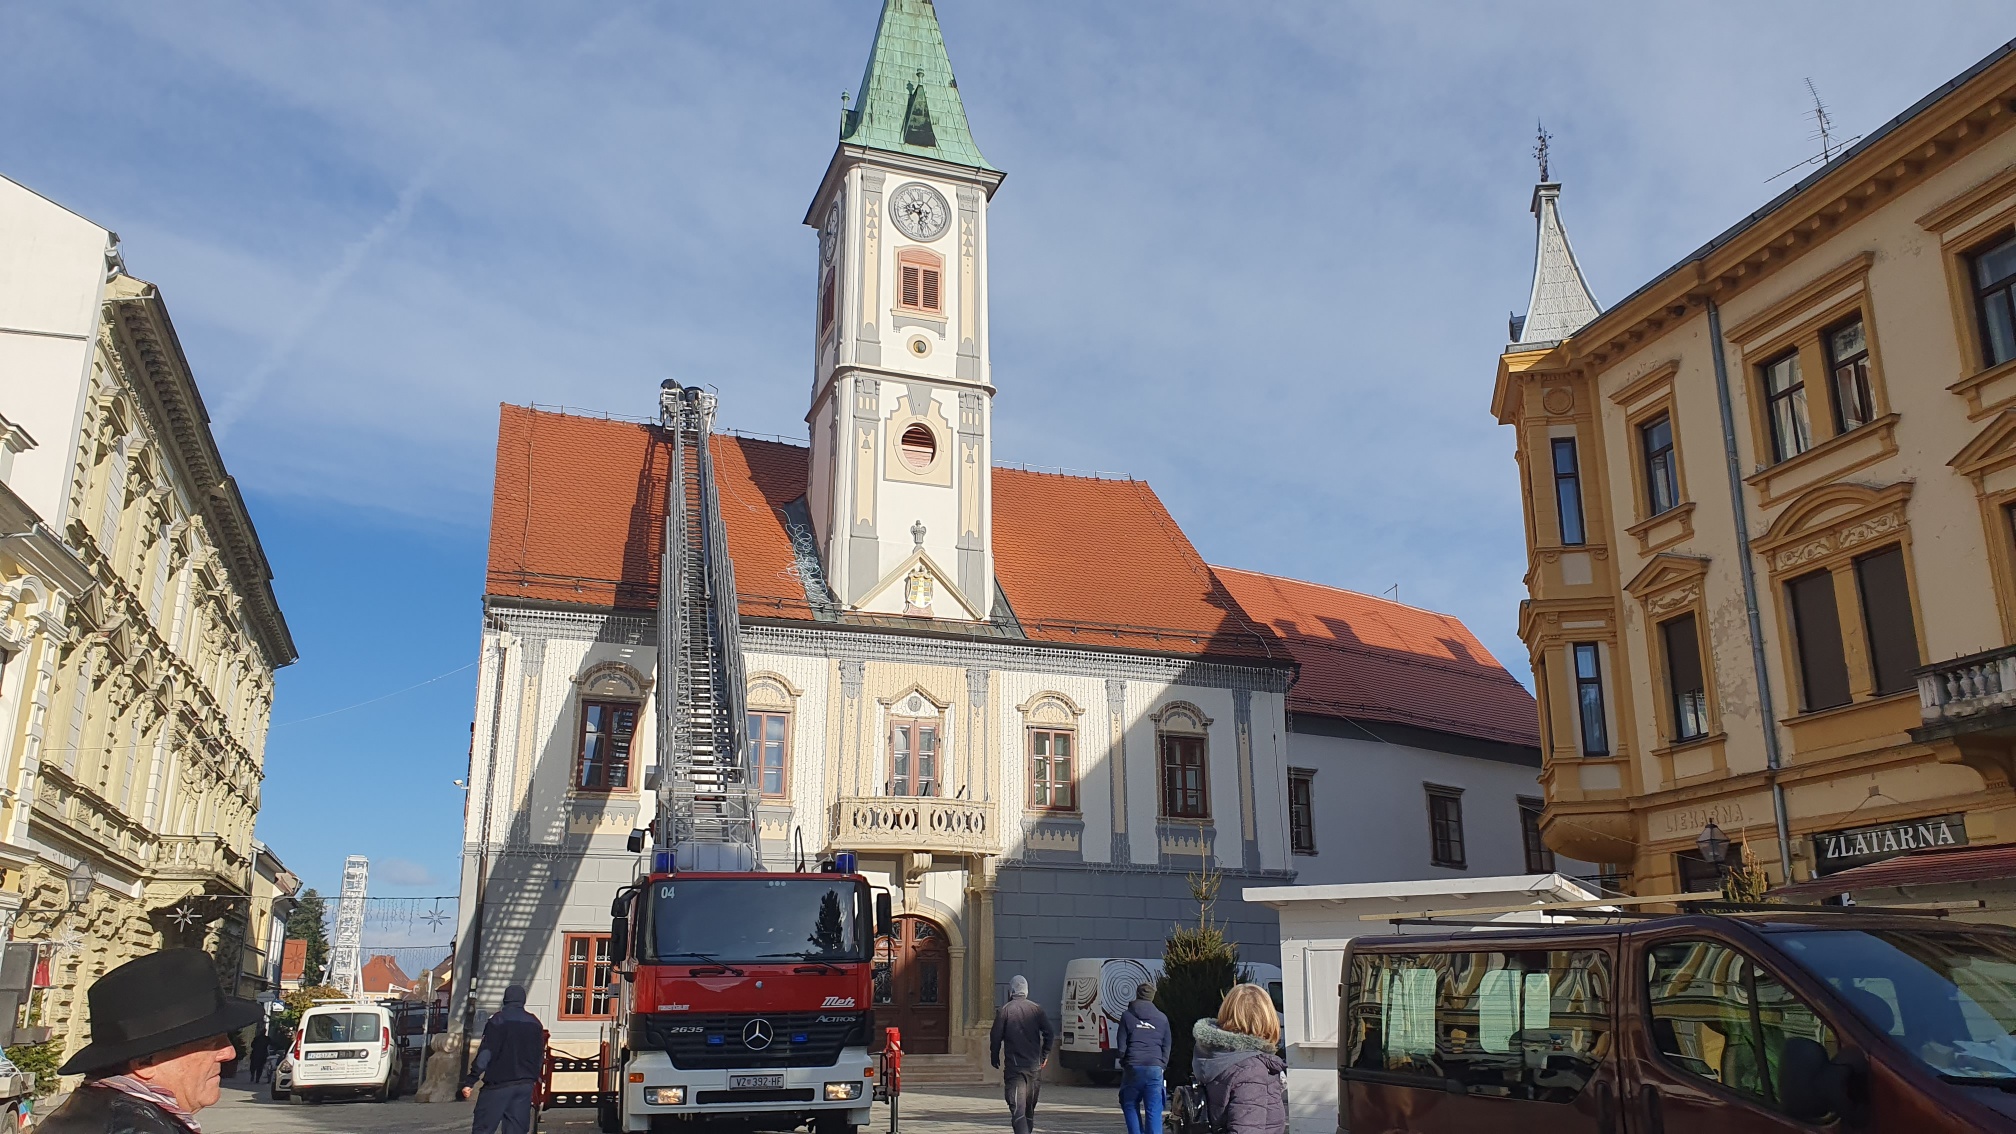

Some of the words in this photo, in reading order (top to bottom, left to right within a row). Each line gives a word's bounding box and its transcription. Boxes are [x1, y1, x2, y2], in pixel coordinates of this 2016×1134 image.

[1825, 820, 1956, 859] ZLATARNA
[661, 886, 675, 899] 04
[820, 996, 855, 1008] Metz
[670, 1026, 704, 1034] 2635
[736, 1077, 746, 1087] VZ
